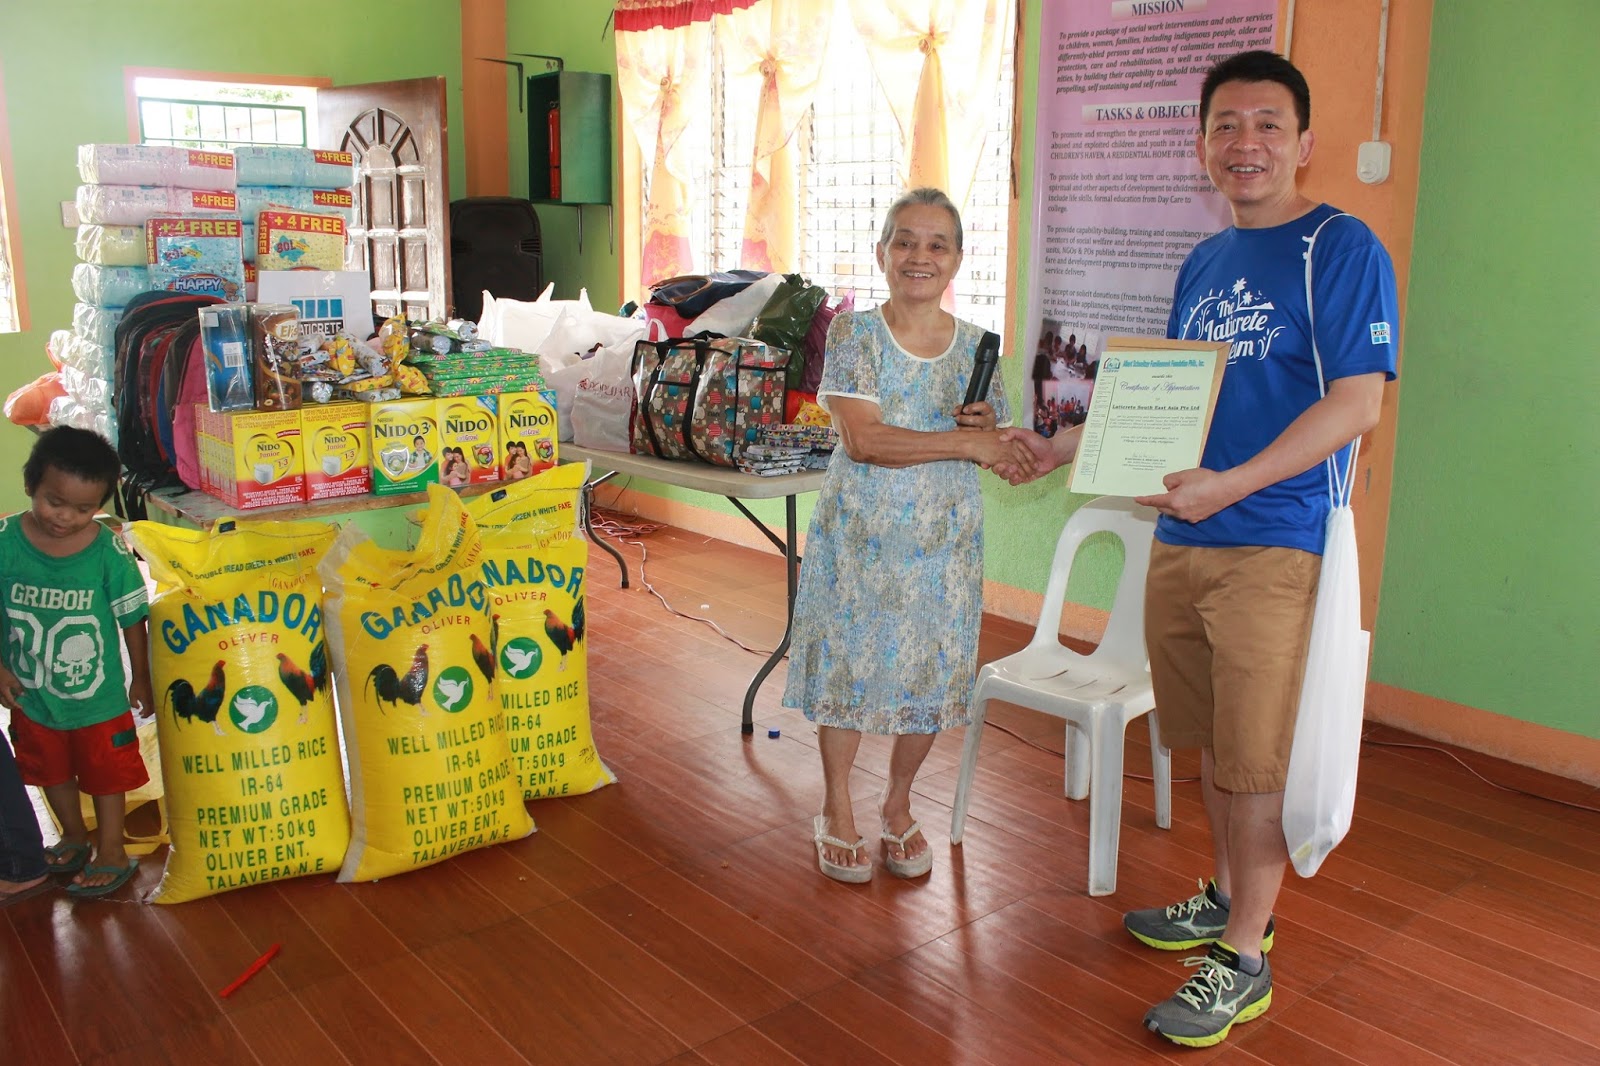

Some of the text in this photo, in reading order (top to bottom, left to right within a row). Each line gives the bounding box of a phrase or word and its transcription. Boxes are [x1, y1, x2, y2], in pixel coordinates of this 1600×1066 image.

[1132, 0, 1184, 16] MISSION
[1060, 32, 1065, 40] To
[1067, 30, 1089, 40] provide
[1096, 27, 1120, 38] package
[1121, 25, 1127, 37] of
[1129, 24, 1146, 33] social
[1148, 23, 1163, 31] work
[1165, 18, 1208, 30] interventions
[1211, 17, 1223, 26] and
[1225, 15, 1244, 24] other
[1245, 13, 1273, 22] services
[1096, 104, 1199, 121] TASKS & OBJECT
[174, 221, 186, 233] 4
[190, 222, 237, 236] FREE
[287, 217, 297, 227] 4
[300, 217, 341, 233] FREE
[174, 277, 222, 291] HAPPY
[1216, 300, 1235, 318] The
[300, 321, 342, 336] ATICRETE
[1227, 339, 1254, 360] eam
[446, 420, 488, 433] NIDO
[510, 414, 548, 428] NIDO
[375, 424, 418, 438] NIDO
[257, 443, 280, 451] NIDO
[538, 505, 557, 515] WHITE
[558, 500, 572, 511] FAKE
[481, 557, 583, 599] NADOR
[10, 582, 94, 610] GRIBOH
[494, 591, 547, 606] OLIVER
[161, 591, 321, 654] GANADOR
[422, 616, 470, 634] OLIVER
[218, 632, 279, 651] OLIVER
[501, 681, 579, 709] MILLED RICE
[506, 714, 541, 731] IR-64
[387, 735, 431, 755] WELL
[437, 721, 485, 750] MILLED
[537, 725, 577, 750] GRADE
[182, 736, 326, 774] WELL MILLED RICE
[447, 750, 480, 774] IR-64
[517, 752, 565, 771] T:50kg
[241, 773, 282, 797] IR-64
[403, 776, 473, 804] PREMIUM
[479, 759, 510, 789] GRADE
[530, 769, 558, 787] ENT.
[197, 788, 328, 826] PREMIUM GRADE
[405, 806, 437, 826] NET
[413, 810, 500, 847] OLIVER ENT.
[199, 830, 231, 849] NET
[206, 841, 309, 871] OLIVER ENT.
